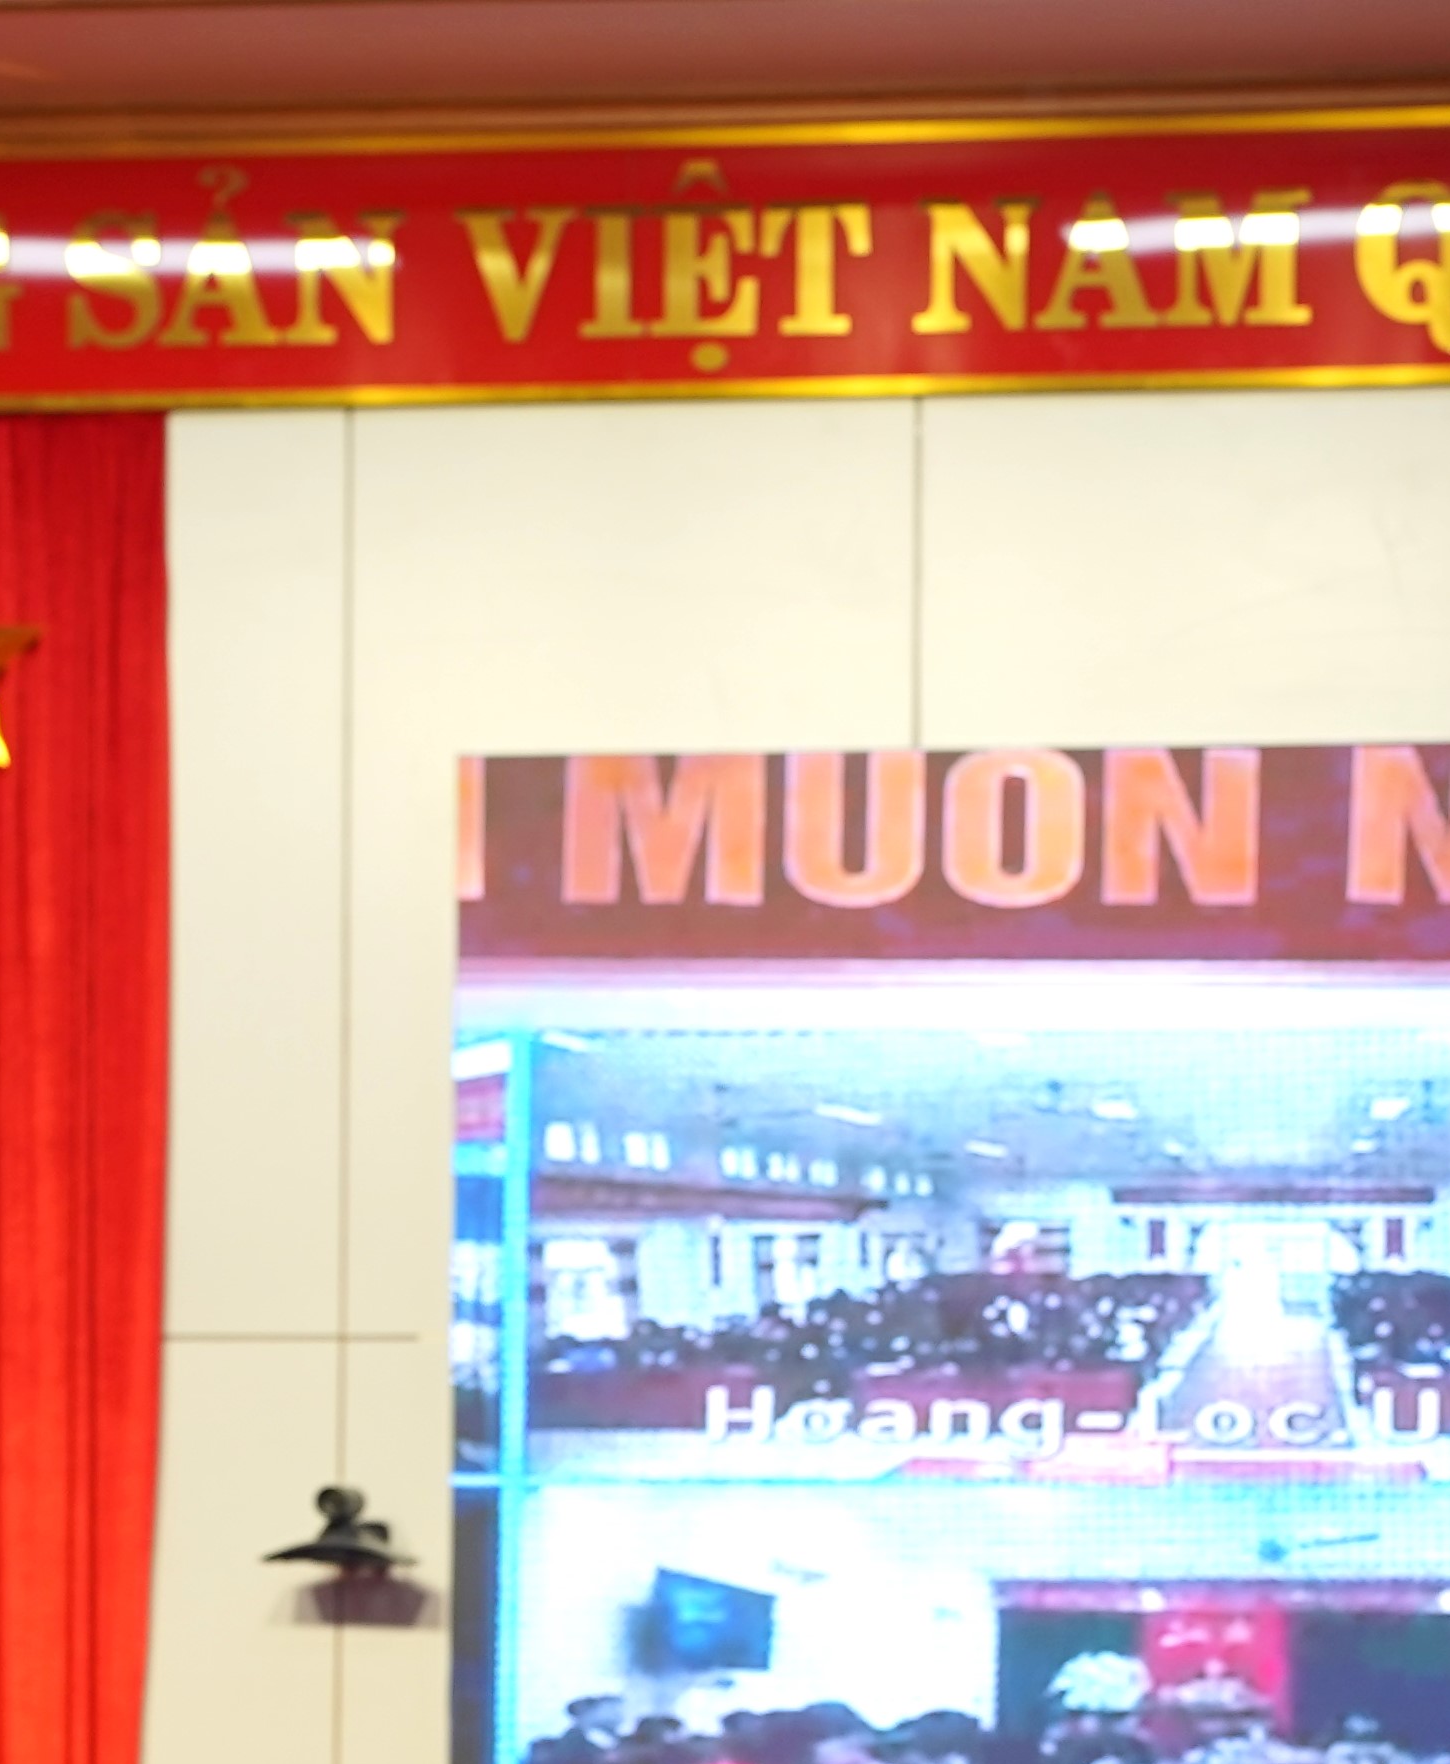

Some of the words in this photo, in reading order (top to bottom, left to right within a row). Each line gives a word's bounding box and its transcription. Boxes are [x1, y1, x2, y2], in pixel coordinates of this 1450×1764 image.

[66, 165, 403, 351] SẢN
[456, 160, 870, 374] VIỆT
[912, 186, 1314, 336] NAM
